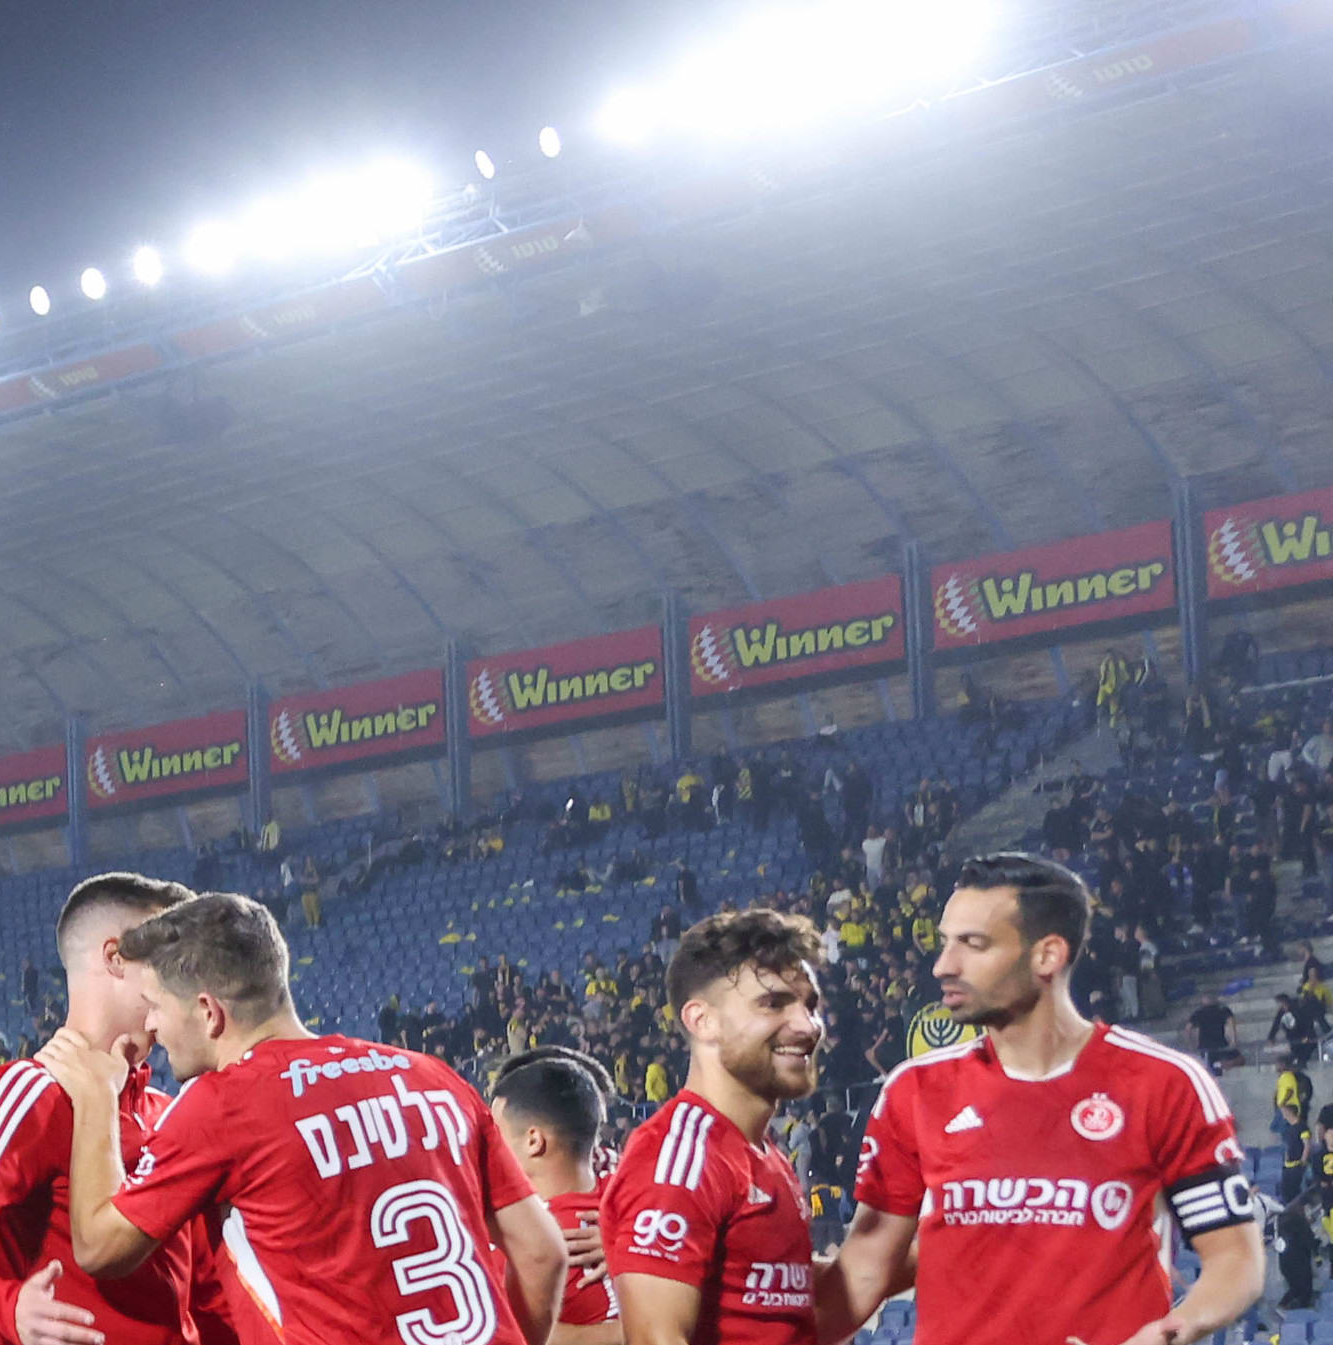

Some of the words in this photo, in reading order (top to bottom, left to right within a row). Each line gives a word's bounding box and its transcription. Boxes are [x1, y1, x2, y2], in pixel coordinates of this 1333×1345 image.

[980, 559, 1164, 619] Winner
[733, 611, 894, 666] Winner
[507, 660, 655, 710] Winner
[305, 702, 437, 748] Winner
[120, 739, 240, 784] Winner
[281, 1048, 411, 1096] freesbe
[942, 1177, 1090, 1210] הכשרה
[633, 1209, 688, 1247] go
[745, 1262, 808, 1290] שרה
